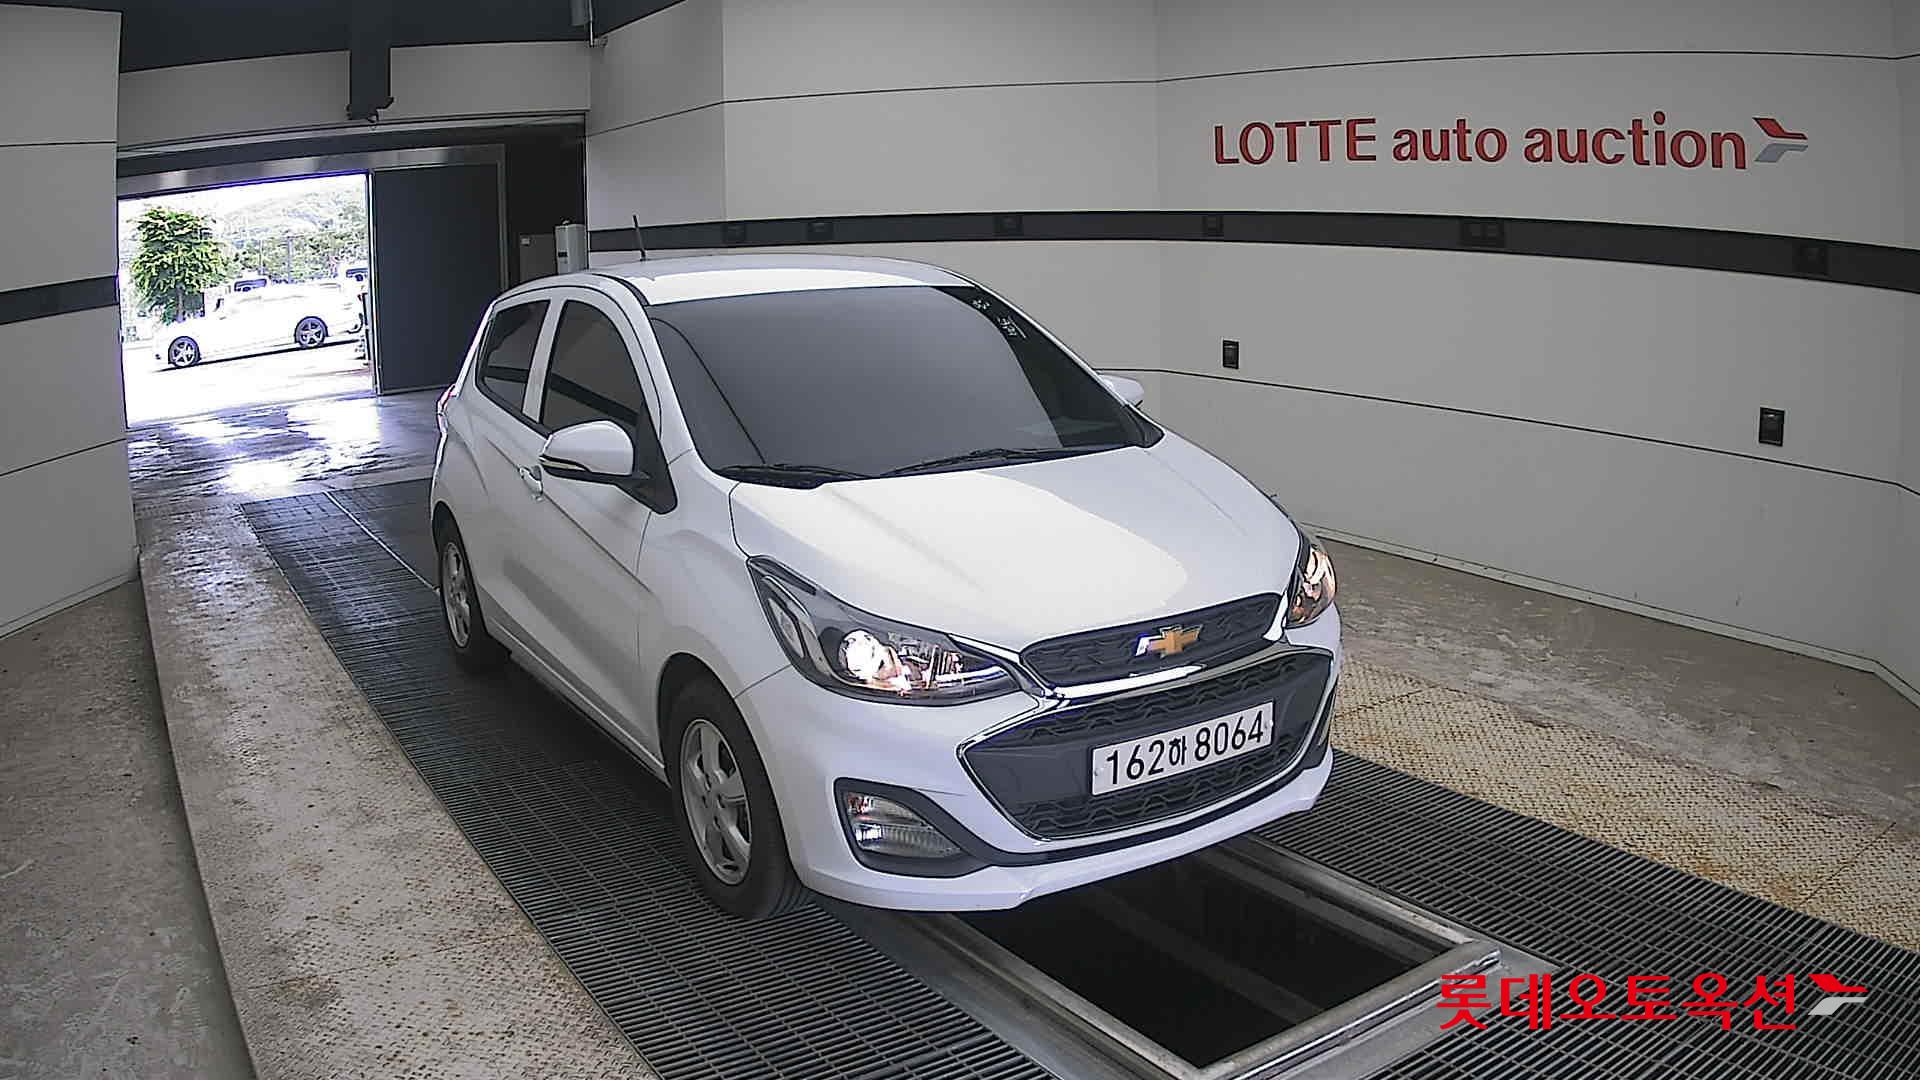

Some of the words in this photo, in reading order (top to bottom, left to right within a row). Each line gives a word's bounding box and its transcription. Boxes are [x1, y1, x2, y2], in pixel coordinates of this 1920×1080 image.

[1213, 118, 1377, 165] LOTTE
[1392, 118, 1508, 162] auto
[1524, 110, 1747, 169] auction
